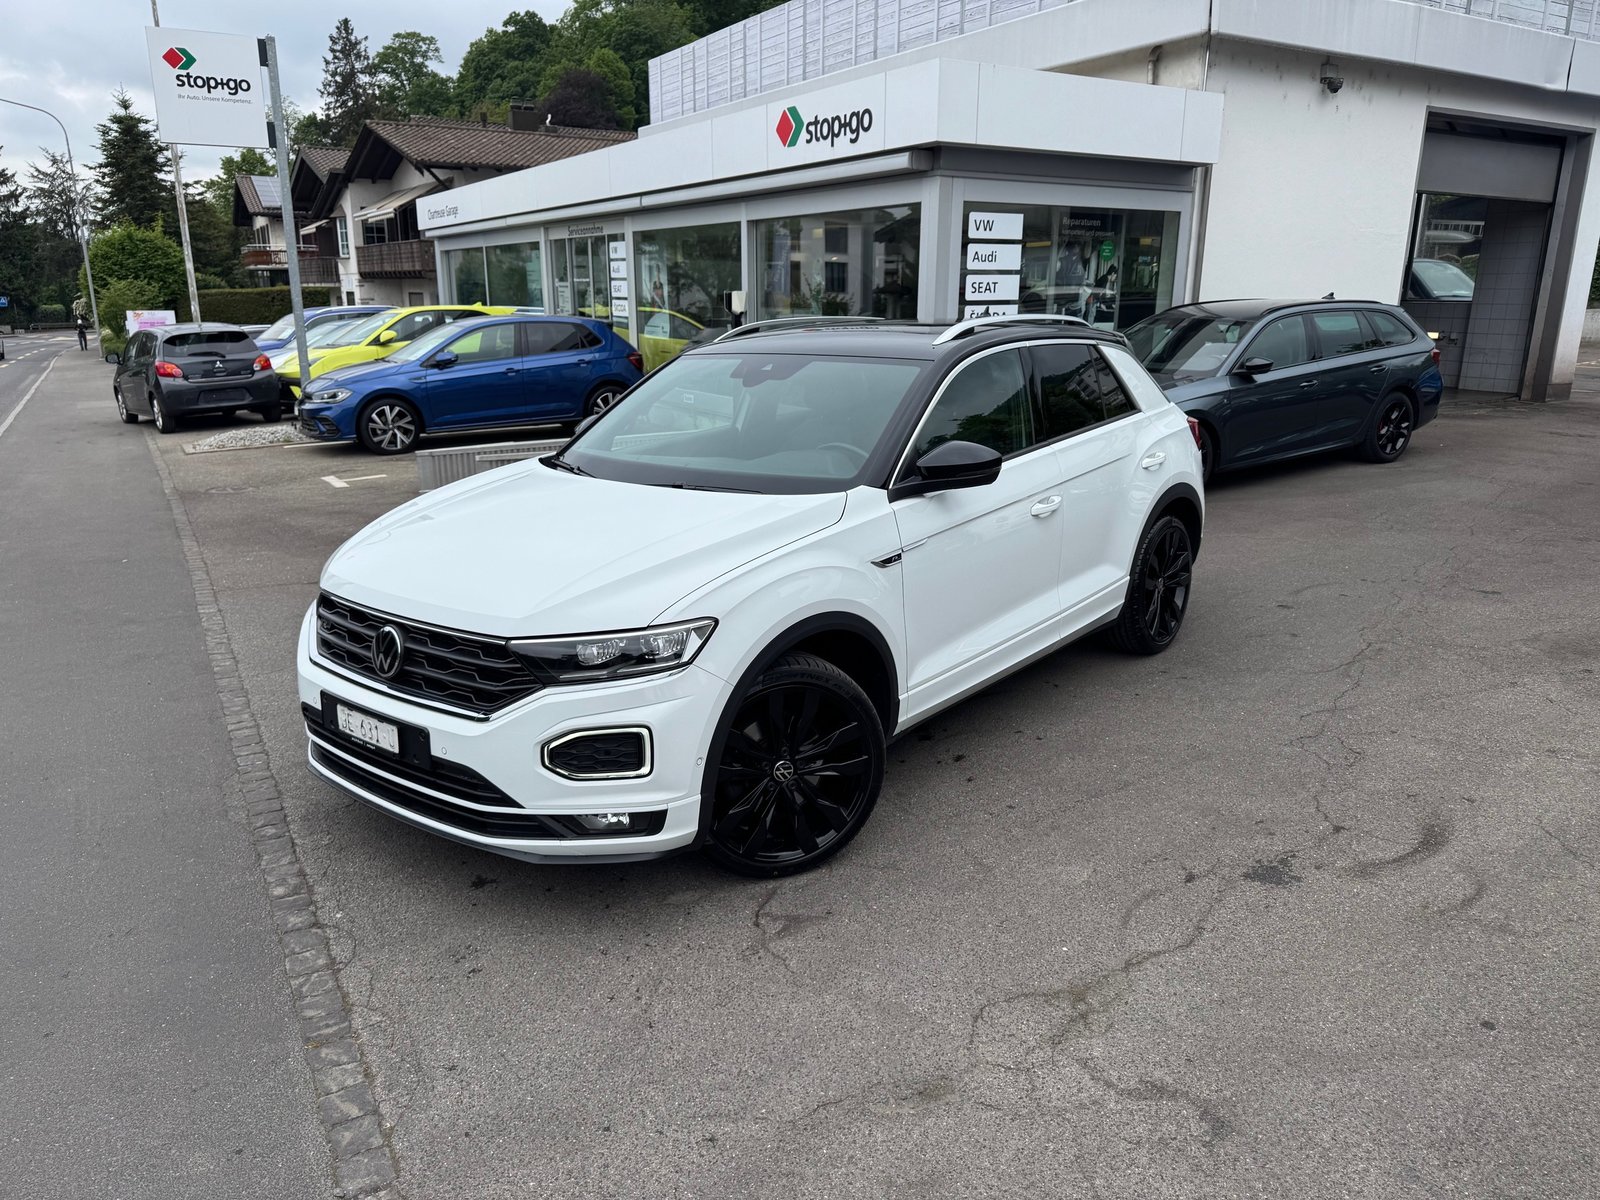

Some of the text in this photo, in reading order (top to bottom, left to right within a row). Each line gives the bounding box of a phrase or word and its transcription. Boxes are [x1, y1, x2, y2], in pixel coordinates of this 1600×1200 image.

[175, 72, 251, 96] stop+go
[805, 108, 873, 148] stop+go
[974, 219, 994, 232] VW
[972, 251, 997, 263] Audi
[971, 281, 998, 294] SEAT
